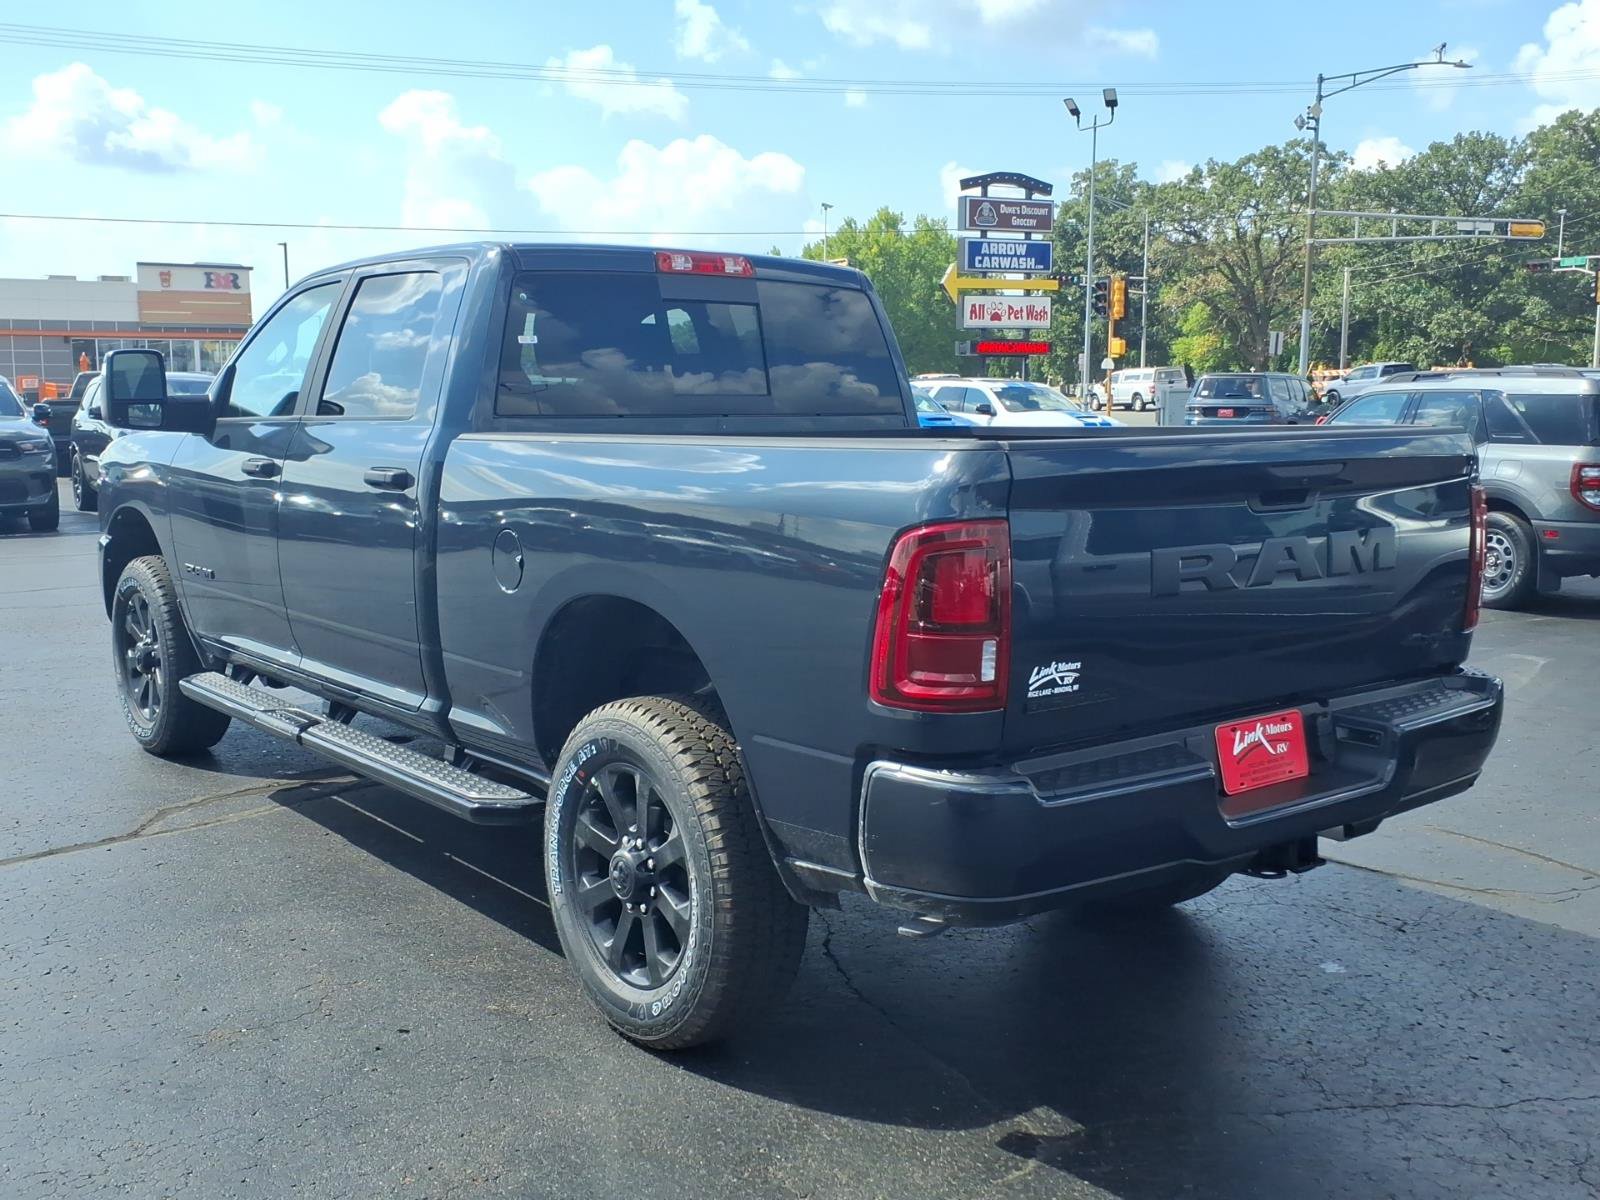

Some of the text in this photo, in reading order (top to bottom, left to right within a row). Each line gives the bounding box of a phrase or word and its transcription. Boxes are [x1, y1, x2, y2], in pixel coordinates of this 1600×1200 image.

[981, 242, 1027, 256] ARROW
[969, 303, 1048, 322] All Pet Wash
[1151, 526, 1397, 597] RAM
[1028, 661, 1062, 685] Link
[1233, 722, 1293, 756] Link Motors
[1276, 742, 1289, 754] RV
[549, 760, 578, 896] TRANSFORCE
